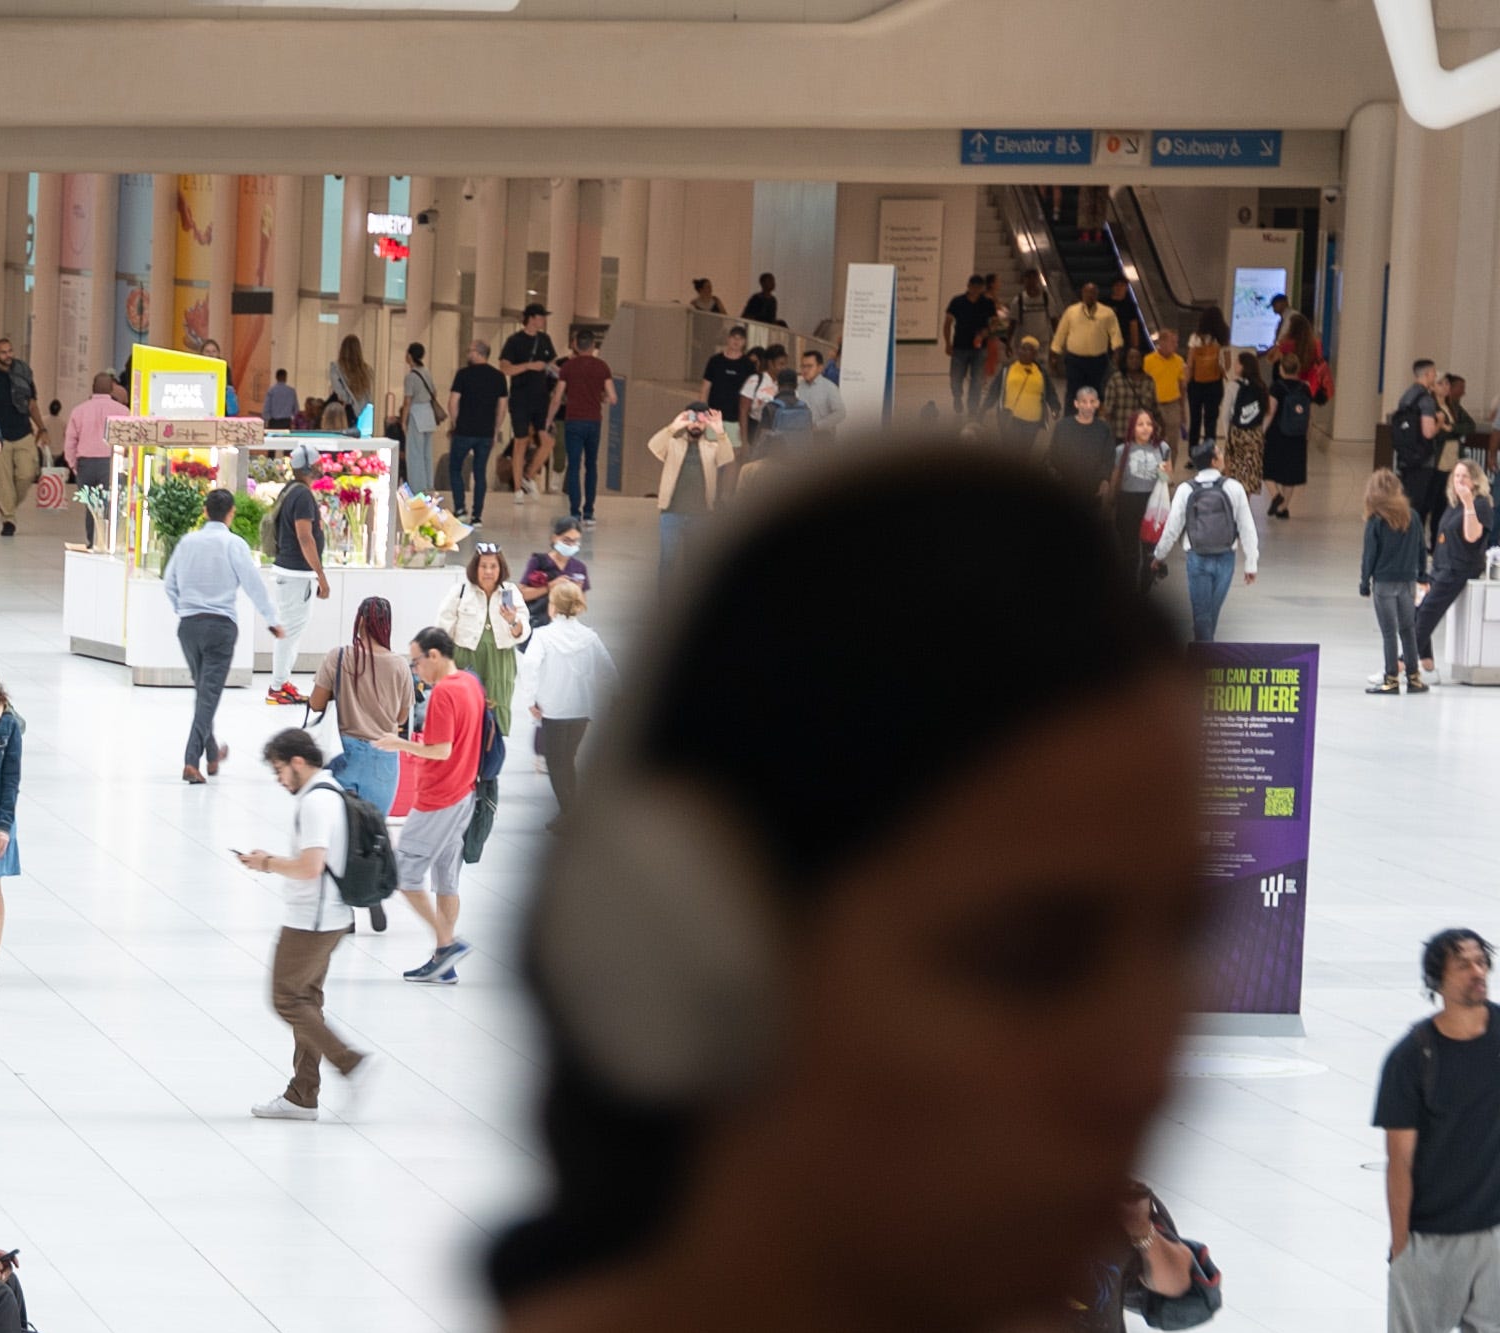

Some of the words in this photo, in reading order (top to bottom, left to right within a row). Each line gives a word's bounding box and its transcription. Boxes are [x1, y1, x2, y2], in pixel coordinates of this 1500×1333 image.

[994, 136, 1051, 154] Elevator
[1174, 137, 1228, 160] Subway
[1227, 669, 1247, 684] CAN
[1249, 669, 1268, 684] GET
[1271, 669, 1300, 684] THERE
[1204, 686, 1252, 712] FROM
[1257, 686, 1300, 713] HERE
